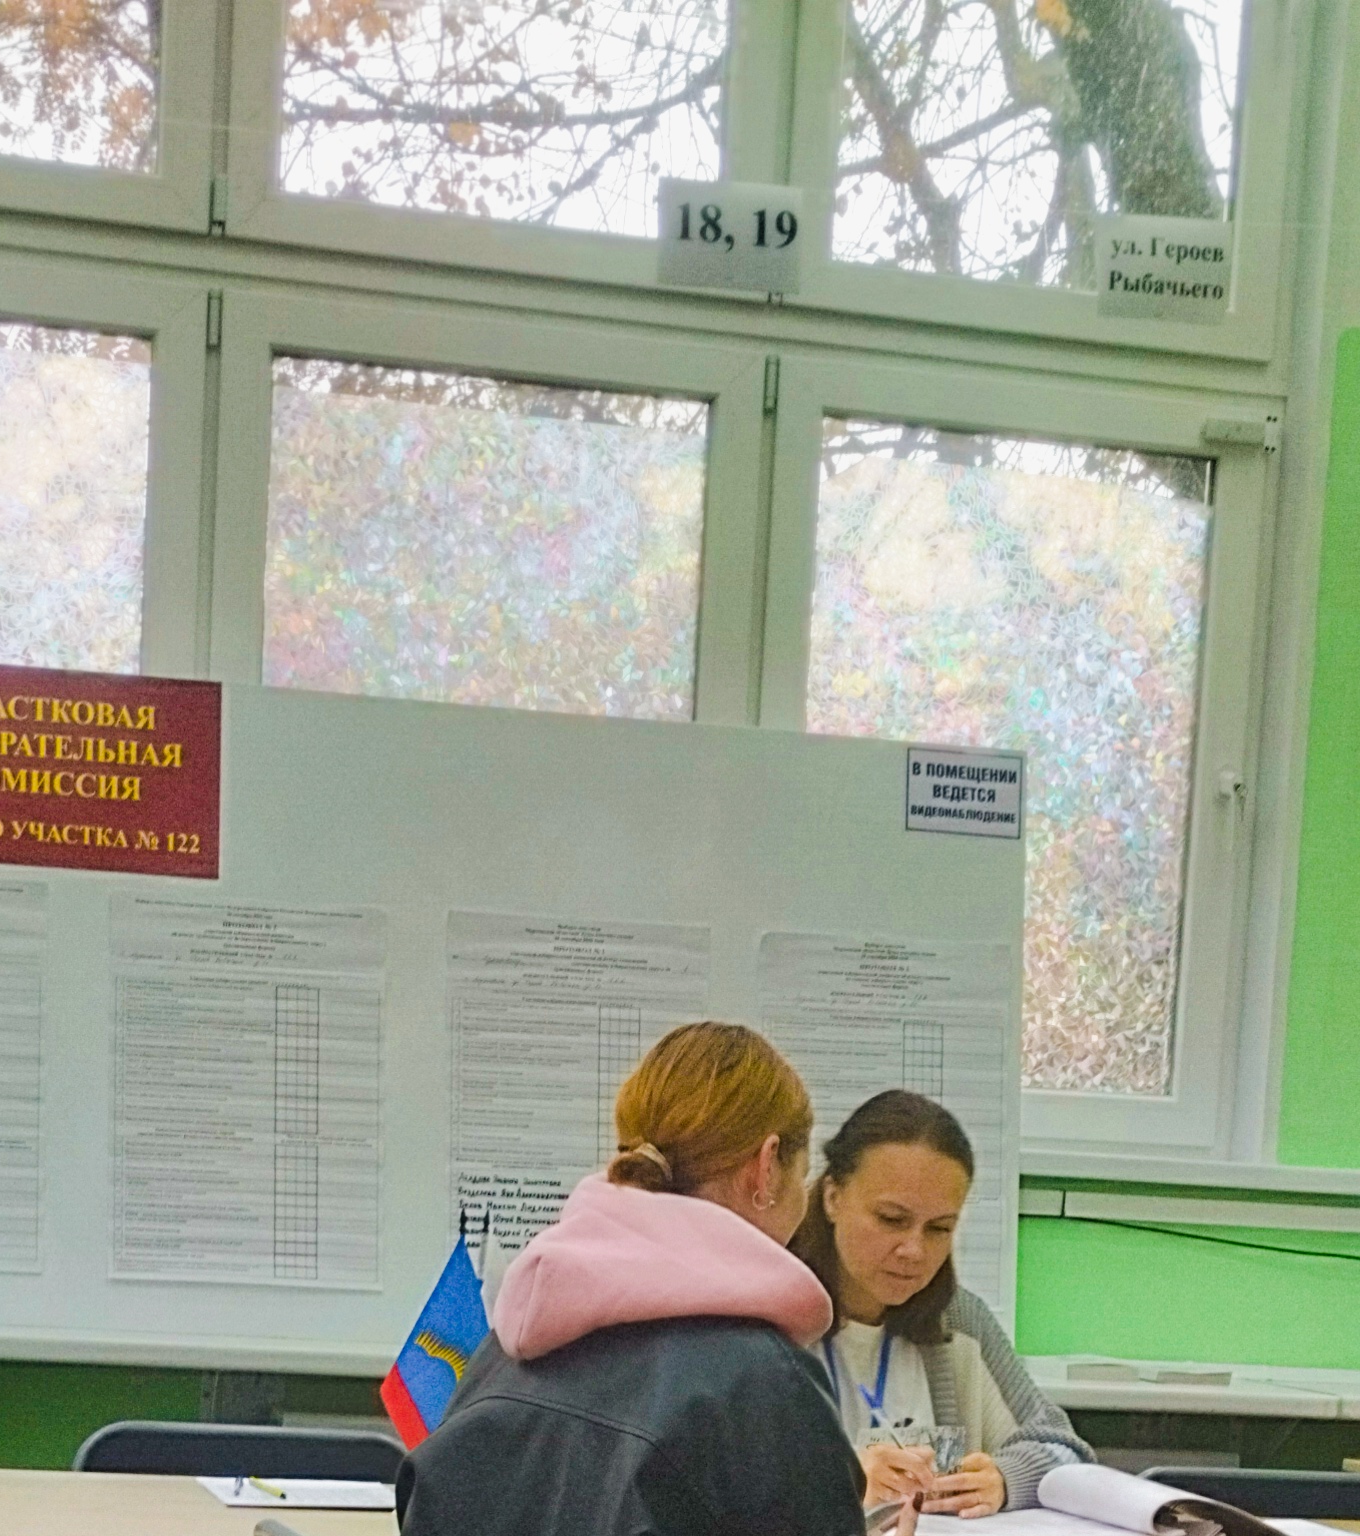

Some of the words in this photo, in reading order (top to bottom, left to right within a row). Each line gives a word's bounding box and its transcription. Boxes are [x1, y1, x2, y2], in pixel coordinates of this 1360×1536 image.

[678, 202, 735, 253] 18,
[752, 208, 798, 249] 19
[1110, 238, 1143, 259] ул.
[1150, 236, 1225, 265] Героев
[1108, 269, 1225, 300] Рыбачьего
[912, 761, 922, 776] В
[926, 762, 1018, 784] ПОМЕЩЕНИИ
[932, 783, 996, 803] ВЕДЕТСЯ
[910, 804, 1017, 824] ВИДЕОНАБЛЮДЕНИЕ
[10, 818, 129, 850] УЧАСТКА
[134, 829, 161, 851] №
[166, 832, 201, 855] 122
